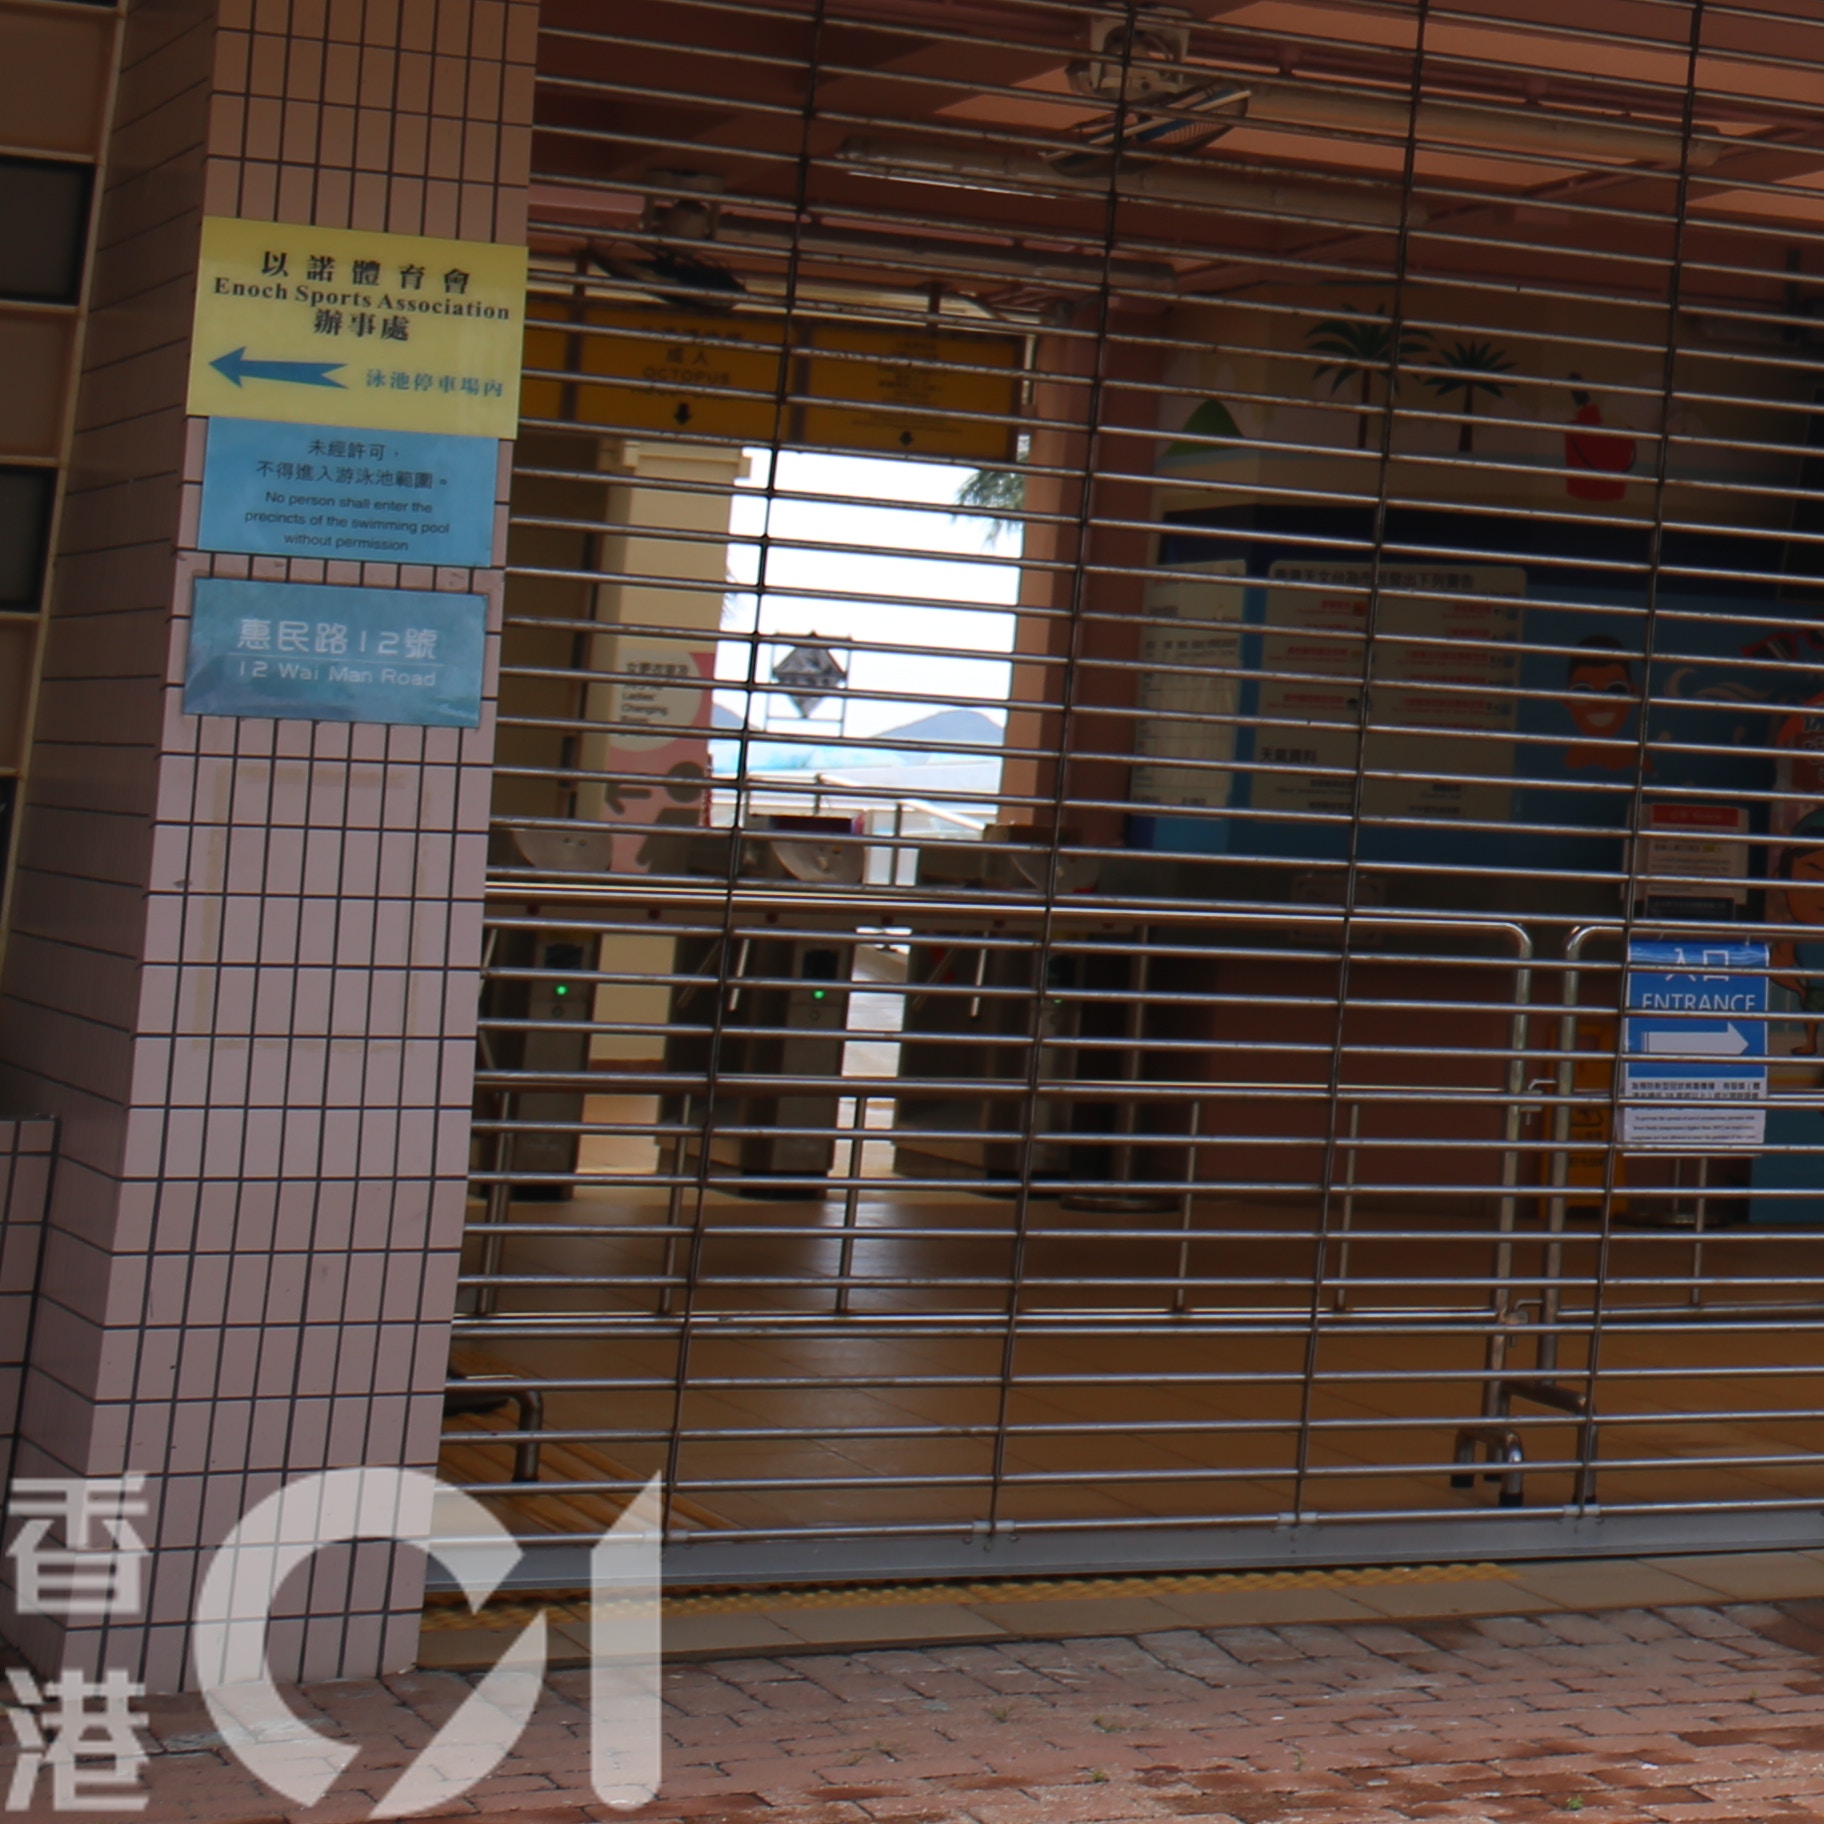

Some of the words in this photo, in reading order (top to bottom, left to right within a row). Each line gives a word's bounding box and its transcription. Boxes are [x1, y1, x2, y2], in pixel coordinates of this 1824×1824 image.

[260, 251, 471, 295] 以諾體育會
[214, 277, 288, 300] Enoch
[295, 285, 372, 308] Sports
[377, 294, 511, 320] Association
[314, 308, 410, 342] 辦事處
[366, 368, 503, 398] 泳池停車場內
[265, 491, 285, 504] No
[289, 493, 334, 509] person
[338, 496, 370, 510] shall
[374, 500, 408, 512] enter
[411, 501, 433, 514] the
[244, 511, 306, 526] precincts
[309, 514, 323, 526] of
[326, 515, 348, 527] the
[351, 517, 418, 535] swimming
[420, 521, 449, 535] pool
[283, 532, 332, 547] without
[335, 535, 409, 553] permission
[237, 618, 440, 661] 惠民路12號
[238, 661, 267, 679] 12
[277, 662, 320, 681] Wai
[329, 664, 373, 684] Man
[381, 667, 436, 688] Road
[1664, 946, 1731, 983] 入口
[1641, 992, 1756, 1012] ENTRANCE
